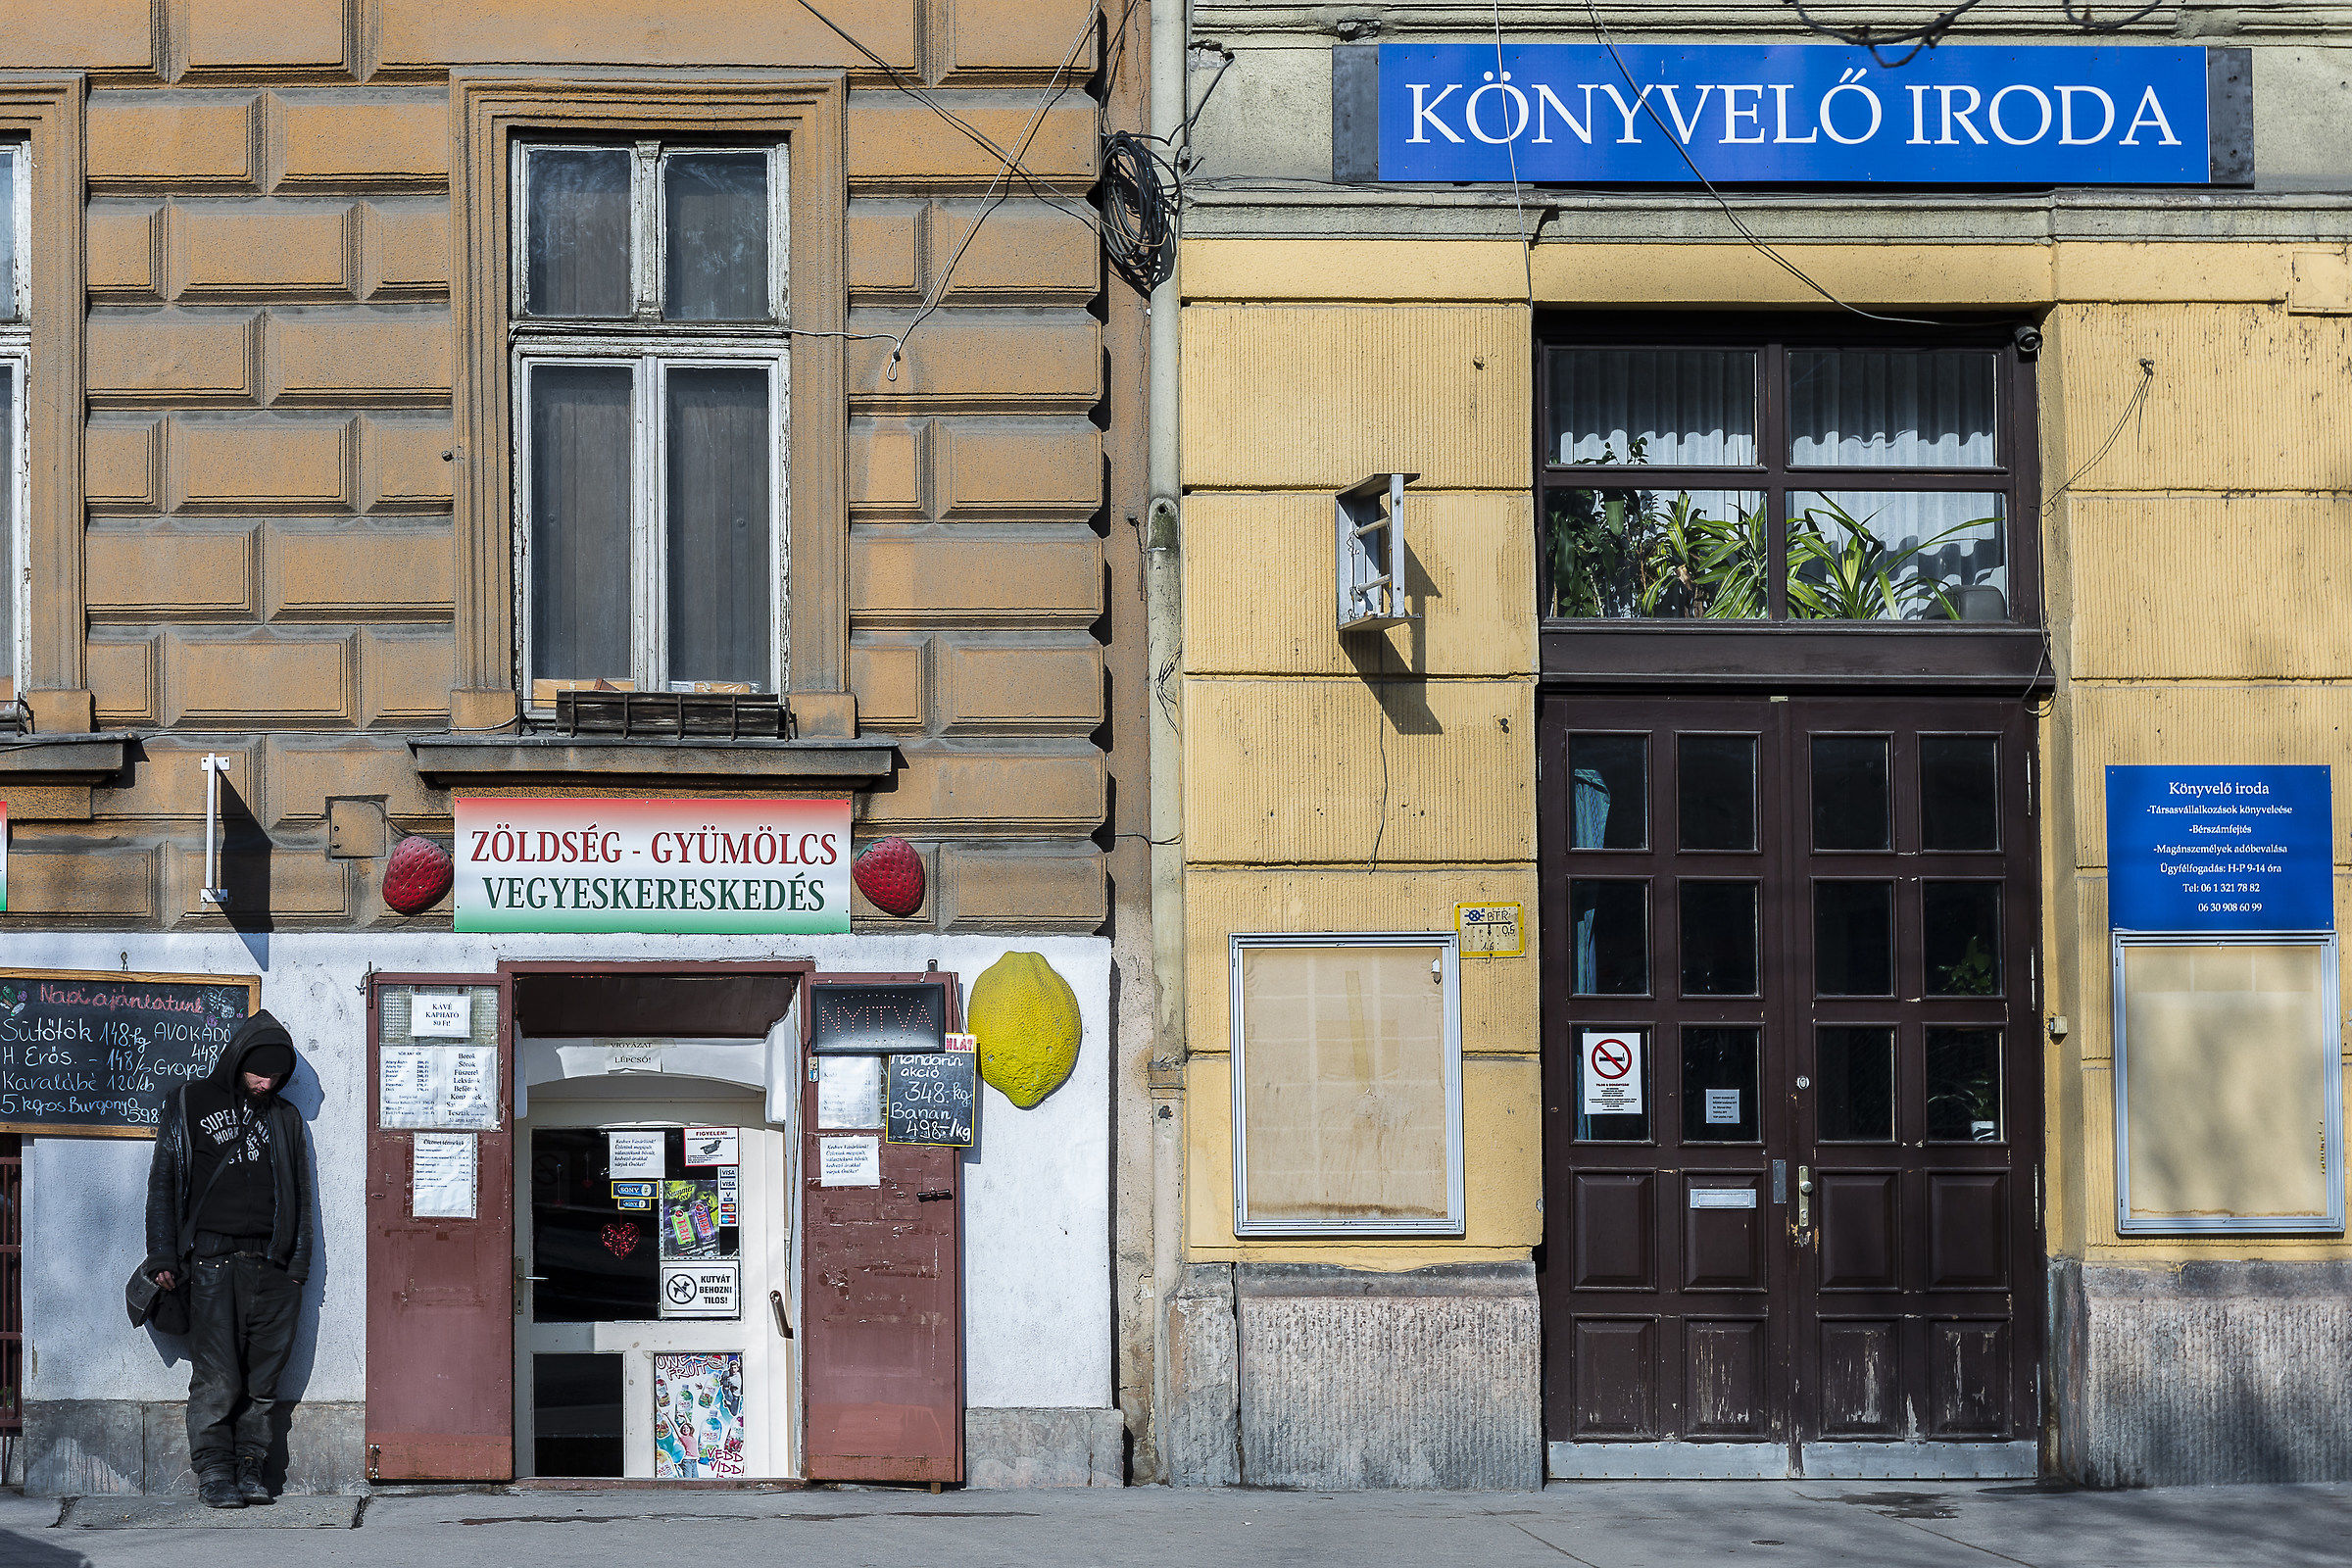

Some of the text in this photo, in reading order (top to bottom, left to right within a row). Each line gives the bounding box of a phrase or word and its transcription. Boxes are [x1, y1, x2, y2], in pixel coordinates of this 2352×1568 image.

[1404, 67, 2182, 146] KÖNYVELŐ IRODA
[2169, 782, 2270, 798] Könyvelő iroda
[470, 821, 621, 863] ZÖLDSÉG
[651, 825, 837, 865] GYÜMÖLCS
[2153, 844, 2232, 856] -Magánszemélyek
[2160, 862, 2281, 875] Ügyfélfogadás: H-P 9-14 óra
[481, 871, 825, 911] VEGYESKERESKEDÉS
[2182, 883, 2260, 893] Tel: 06 1 321 78 82
[2198, 903, 2262, 912] 06 30 908 60 99
[1487, 909, 1509, 922] BTR
[39, 983, 91, 1006] Napi
[821, 1004, 934, 1033] NYITVA
[0, 1016, 93, 1042] Sütőtök
[900, 1066, 940, 1079] akció
[700, 1273, 731, 1284] KUTYÁT
[699, 1286, 733, 1295] BEHOZNI
[707, 1446, 744, 1462] VEDD
